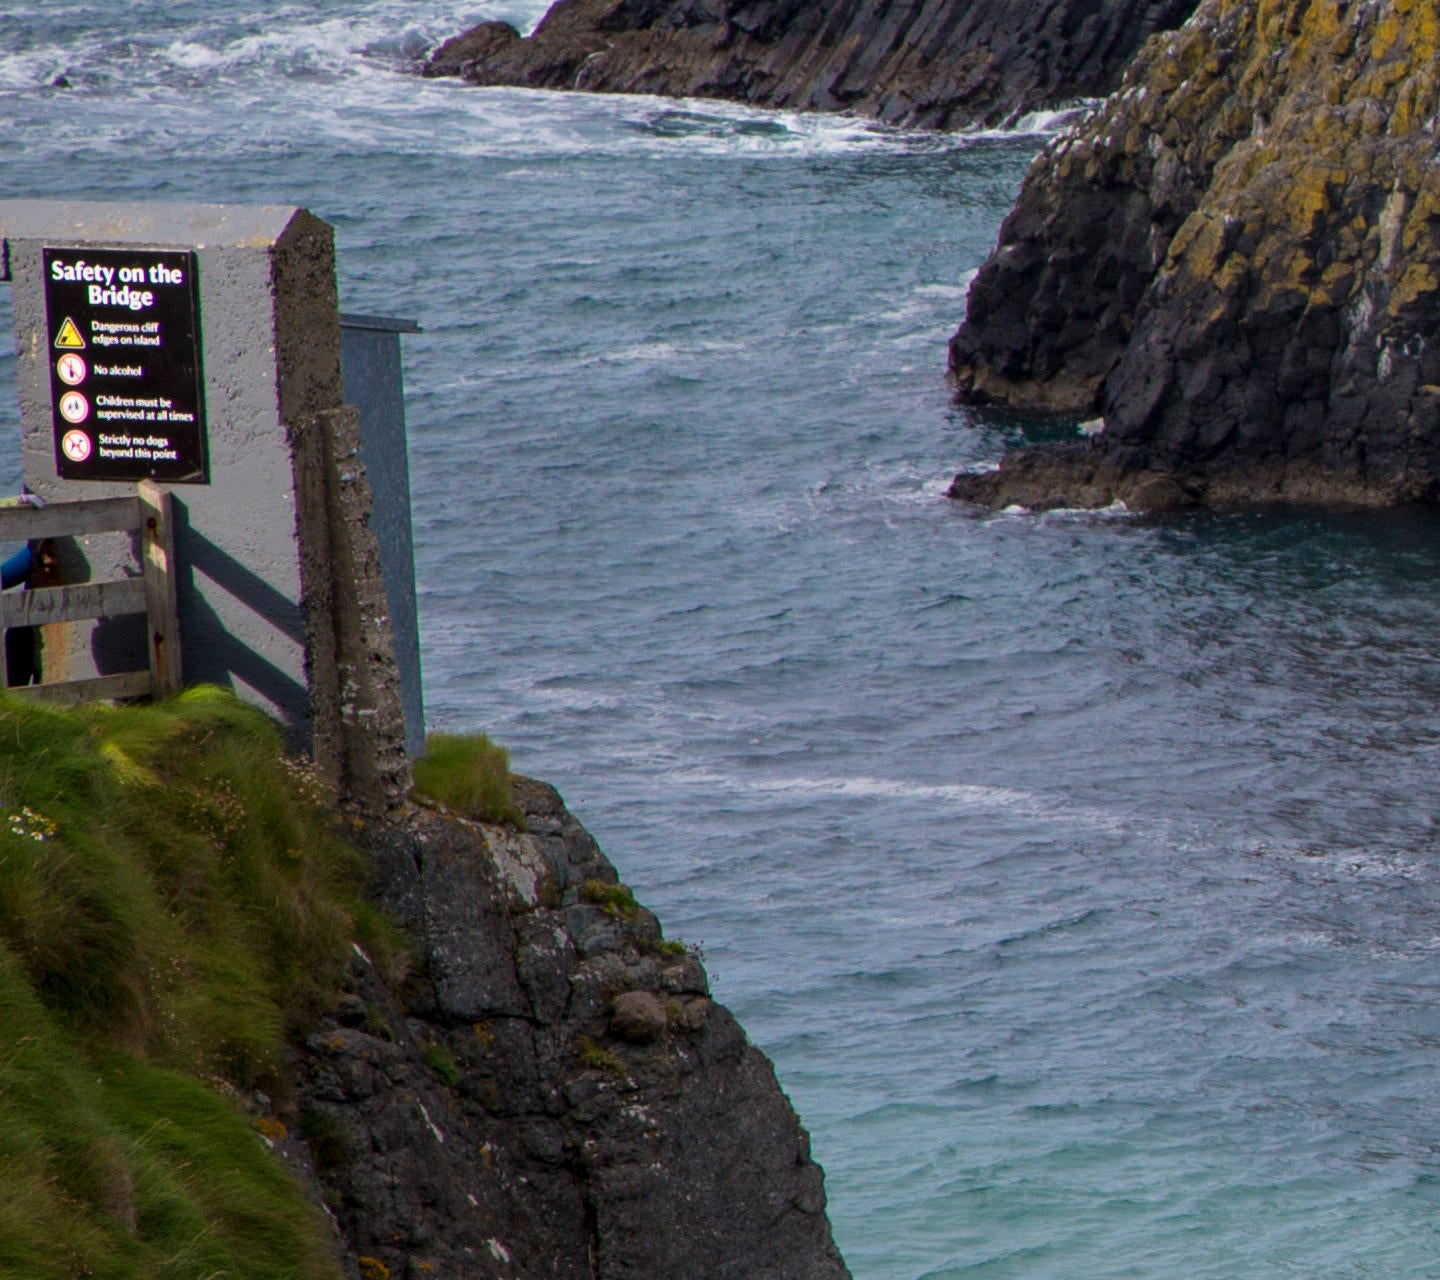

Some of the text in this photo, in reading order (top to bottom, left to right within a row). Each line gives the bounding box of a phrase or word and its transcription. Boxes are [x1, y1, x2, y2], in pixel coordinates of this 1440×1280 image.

[51, 260, 183, 286] Safety on the
[88, 284, 154, 311] Bridge
[91, 320, 159, 334] Dangerous cliff
[92, 334, 160, 346] edges on island
[93, 364, 142, 376] No alcohol
[96, 395, 172, 408] Children must be
[97, 409, 194, 422] supervised at all times
[99, 434, 169, 448] Strictly no dogs
[99, 447, 177, 460] beyond this point
